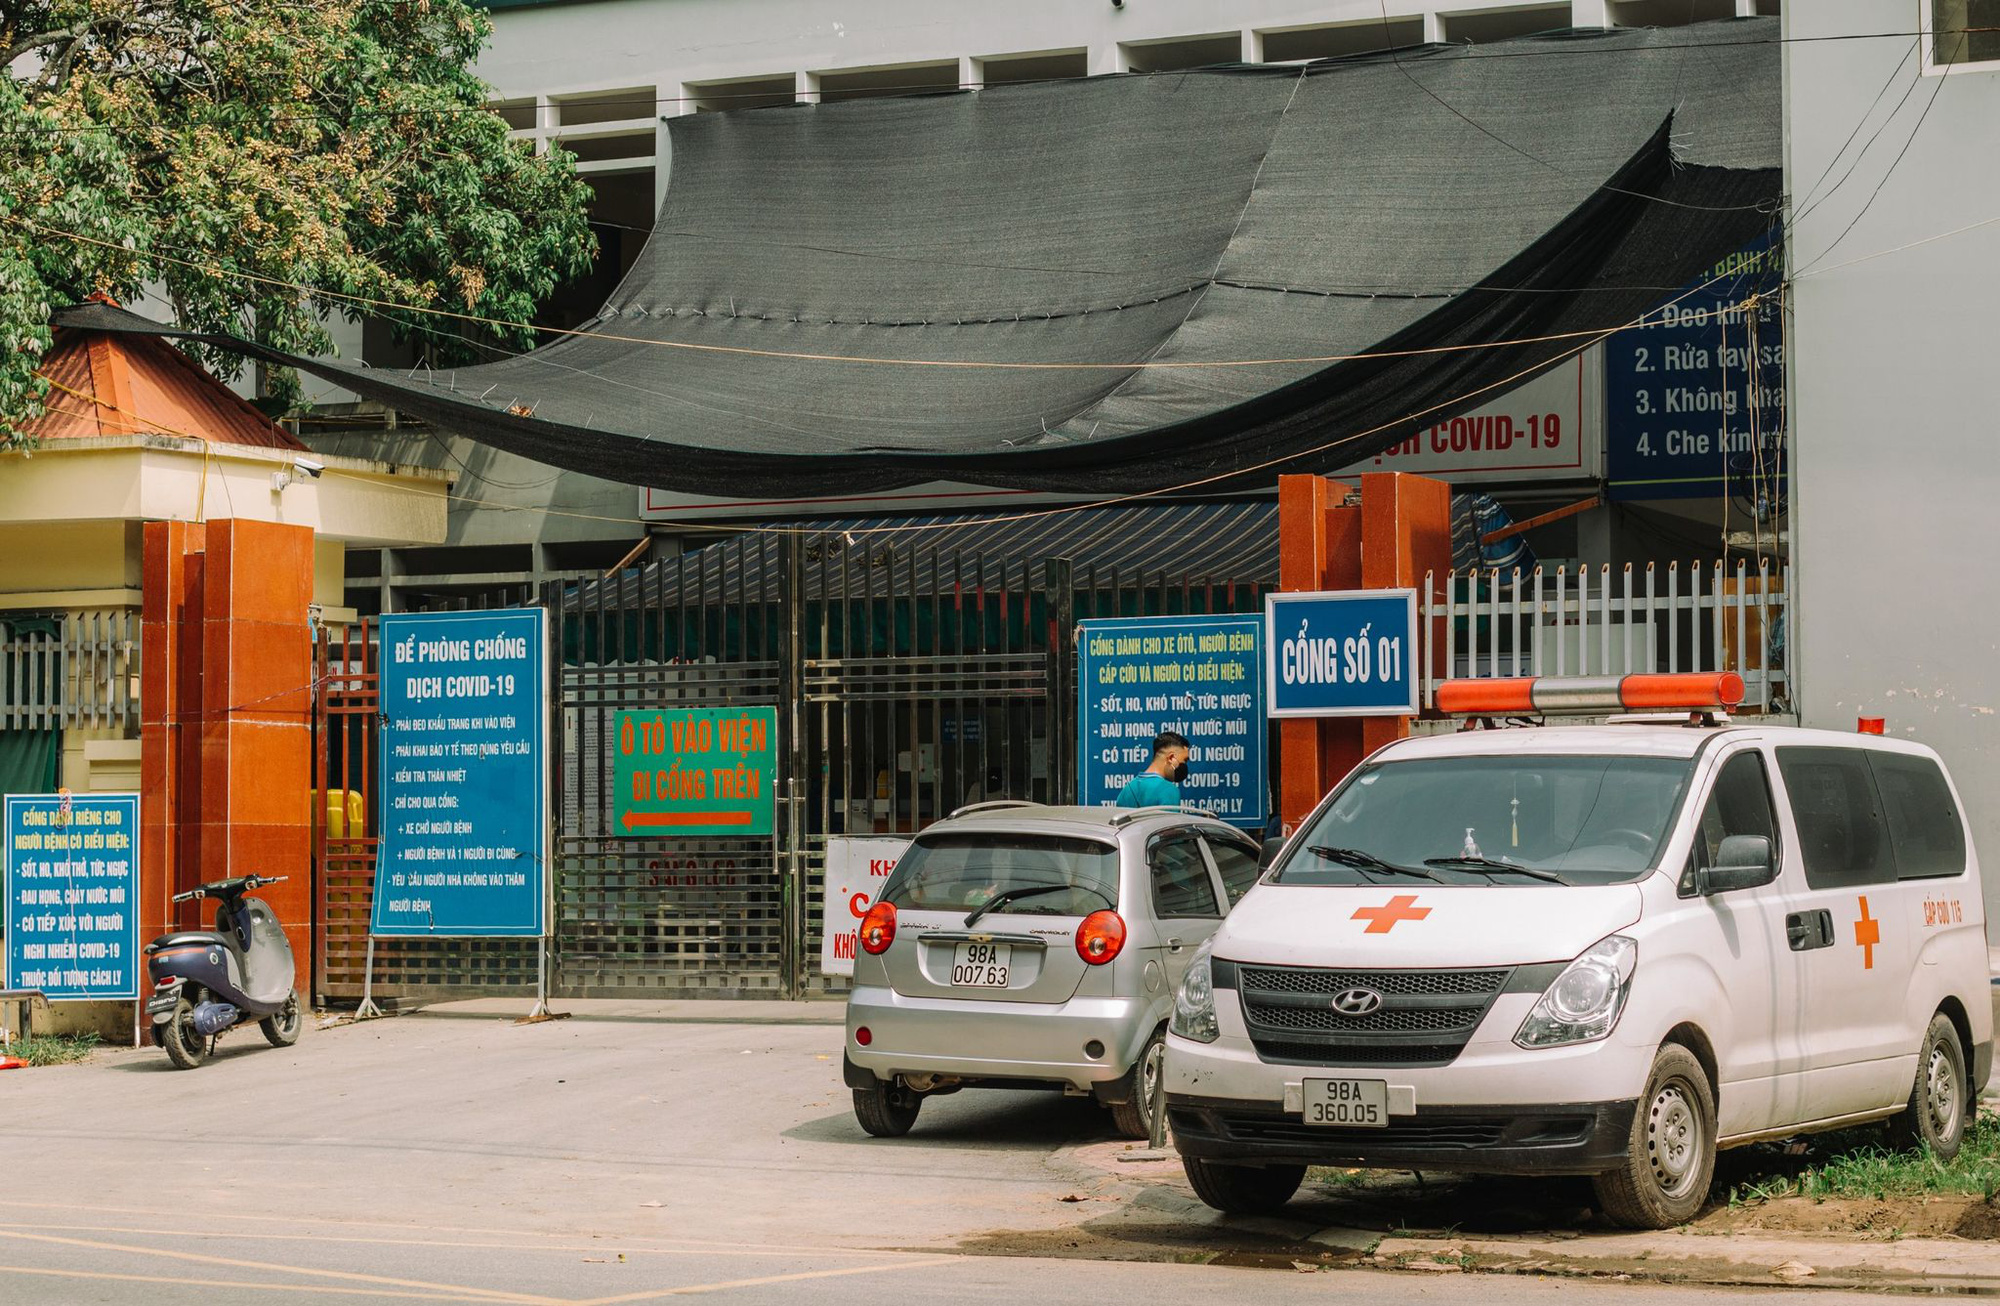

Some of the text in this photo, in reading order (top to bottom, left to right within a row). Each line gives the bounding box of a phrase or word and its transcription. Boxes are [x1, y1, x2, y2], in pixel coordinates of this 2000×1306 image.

[1662, 304, 1708, 328] Đeo
[1635, 348, 1655, 372] 2.
[1664, 342, 1708, 370] Rửa
[1636, 390, 1656, 414] 3.
[1665, 387, 1736, 415] Không
[1430, 413, 1560, 453] COVID-19
[1636, 432, 1656, 456] 4.
[1666, 430, 1709, 454] Che
[1718, 426, 1751, 452] kín
[395, 631, 526, 663] ĐỂ PHÒNG CHỐNG
[1116, 635, 1141, 656] DÀNH
[1143, 637, 1161, 655] CHO
[1163, 637, 1175, 654] XE
[1199, 631, 1227, 653] NGƯỜI
[1229, 630, 1254, 655] BỆNH
[1282, 618, 1400, 685] CỔNG SỐ 01
[1099, 660, 1117, 684] CẤP
[1119, 662, 1137, 683] CỨU
[1140, 661, 1151, 682] VÀ
[1153, 660, 1180, 682] NGƯỜI
[1183, 661, 1195, 682] CÓ
[1220, 659, 1245, 684] HIỆN:
[406, 674, 515, 703] DỊCH COVID-19
[1101, 692, 1123, 714] SỐT,
[1125, 697, 1142, 712] HO,
[1146, 694, 1168, 711] KHÓ
[1196, 693, 1218, 710] TỨC
[1221, 693, 1252, 713] NGỰC
[413, 718, 426, 731] ĐEO
[448, 718, 470, 730] TRANG
[471, 718, 483, 730] KHI
[484, 714, 498, 729] VÀO
[500, 714, 516, 731] VIỆN
[1125, 722, 1157, 740] HỌNG,
[1192, 718, 1222, 735] NƯỚC
[1225, 717, 1247, 735] MŨI
[620, 715, 635, 756] Ô
[640, 715, 666, 754] TÔ
[671, 714, 712, 754] VÀO
[718, 712, 766, 758] VIỆN
[412, 744, 428, 757] KHAI
[430, 742, 443, 756] BÁO
[444, 744, 450, 756] Y
[451, 740, 459, 756] TẾ
[460, 744, 478, 756] THEO
[1102, 743, 1244, 763] CÓ TIẾP ỚI NGƯỜI
[413, 771, 426, 782] TRA
[446, 768, 466, 784] NHIỆT
[632, 771, 650, 801] ĐI
[712, 762, 760, 799] TRÊN
[1183, 772, 1240, 788] COVID-19
[407, 796, 421, 808] CHO
[423, 796, 437, 808] QUA
[1231, 798, 1243, 813] LY
[76, 808, 101, 825] RIÊNG
[104, 810, 122, 825] CHO
[406, 822, 414, 834] XE
[431, 821, 452, 834] NGƯỜI
[454, 820, 472, 836] BỆNH
[15, 832, 42, 850] NGƯỜI
[44, 832, 68, 852] BỆNH
[70, 832, 82, 849] CÓ
[106, 831, 129, 852] HIỆN:
[404, 846, 516, 862] NGƯỜI BỆNH VÀ 1 NGƯỜI ĐI CÙNG
[21, 857, 38, 880] SỐT,
[39, 863, 52, 879] HO,
[54, 860, 70, 878] KHÓ
[90, 859, 105, 877] TỨC
[106, 859, 128, 880] NGỰC
[424, 872, 445, 886] NGƯỜI
[447, 872, 462, 886] NHÀ
[463, 872, 487, 886] KHÔNG
[489, 872, 504, 886] VÀO
[21, 889, 37, 905] ĐAU
[38, 889, 62, 908] HỌNG,
[86, 886, 108, 904] NƯỚC
[412, 898, 431, 914] BỆNH
[22, 912, 123, 932] CÓ TIẾP XÚC VỚI NGƯỜI
[24, 944, 45, 959] NGHI
[79, 942, 120, 959] COVID-19
[967, 944, 997, 964] 98A
[21, 966, 122, 989] THUỘC ĐỐI TƯỢNG CÁCH LY
[954, 966, 1008, 985] 007.63
[1327, 1082, 1362, 1100] 98A
[1313, 1103, 1377, 1122] 360.05
